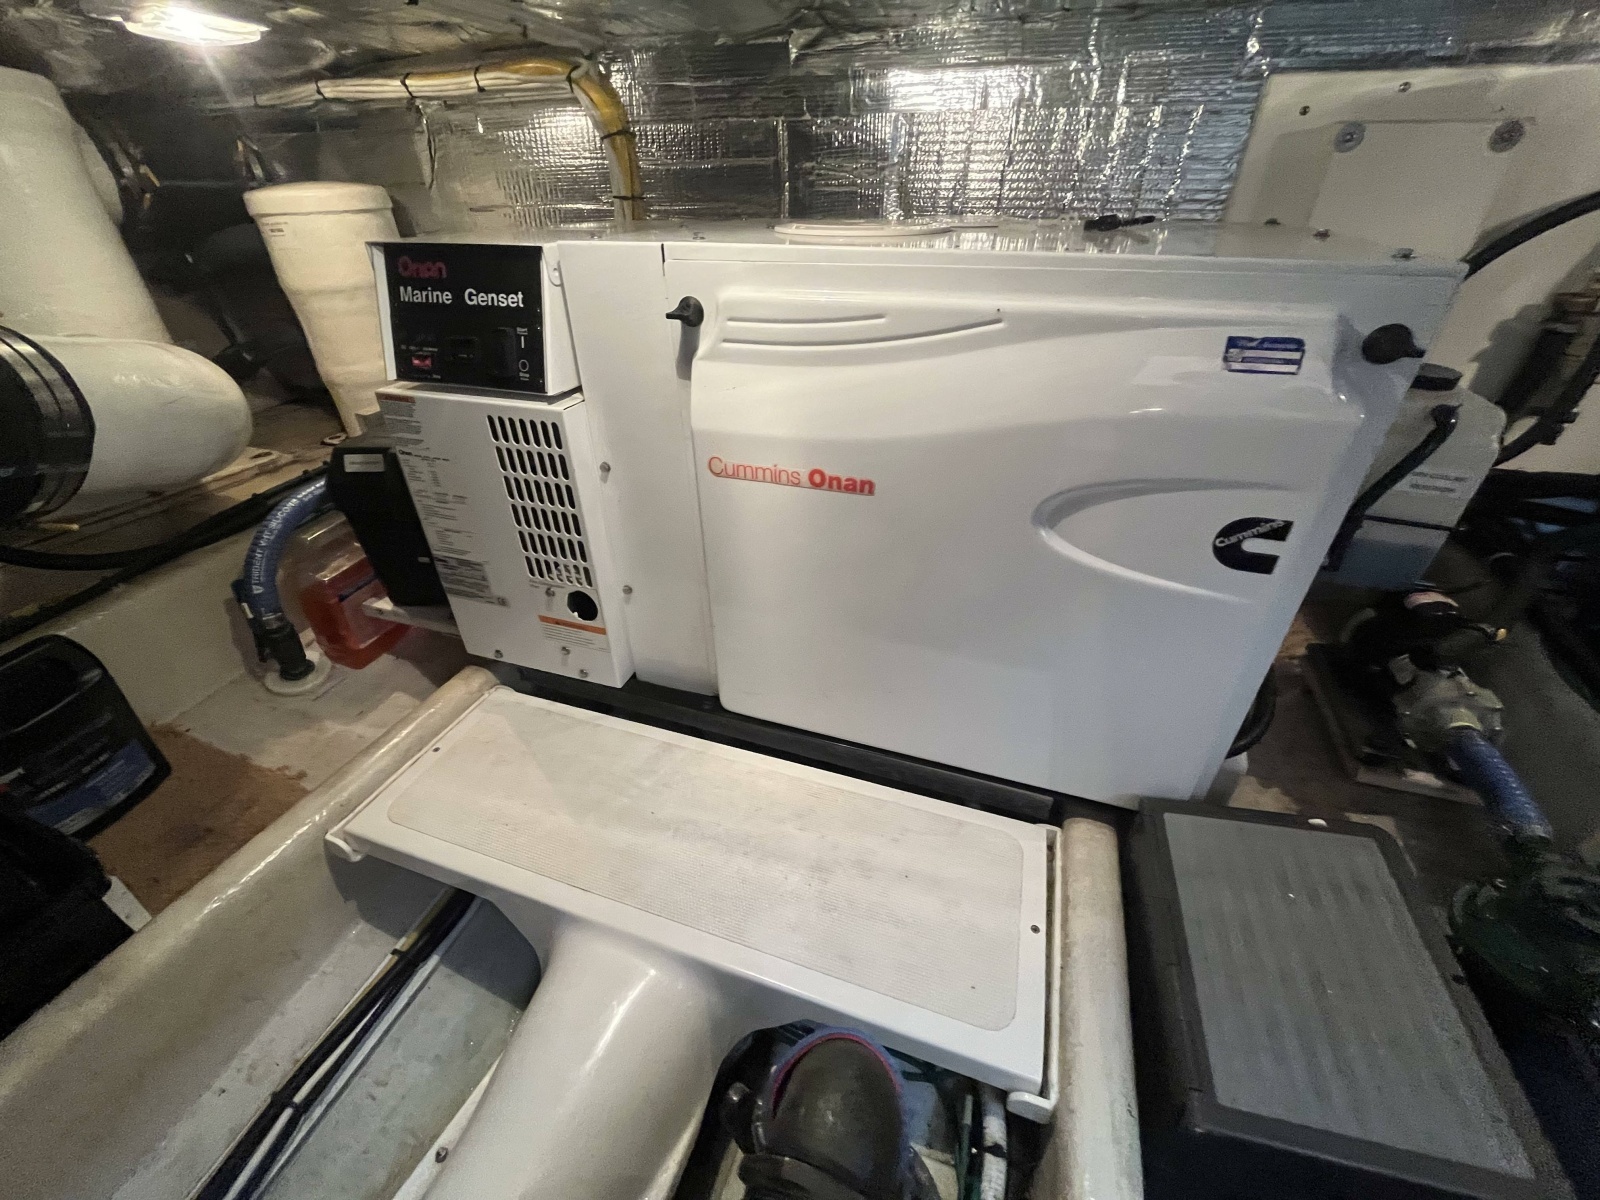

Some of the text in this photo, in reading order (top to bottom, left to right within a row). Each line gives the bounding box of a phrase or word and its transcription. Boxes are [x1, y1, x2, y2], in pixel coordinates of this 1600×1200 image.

[398, 256, 448, 279] Onan
[399, 286, 525, 308] Marine Genset
[708, 455, 875, 495] Cummins Onan
[251, 547, 264, 584] TRIDENT
